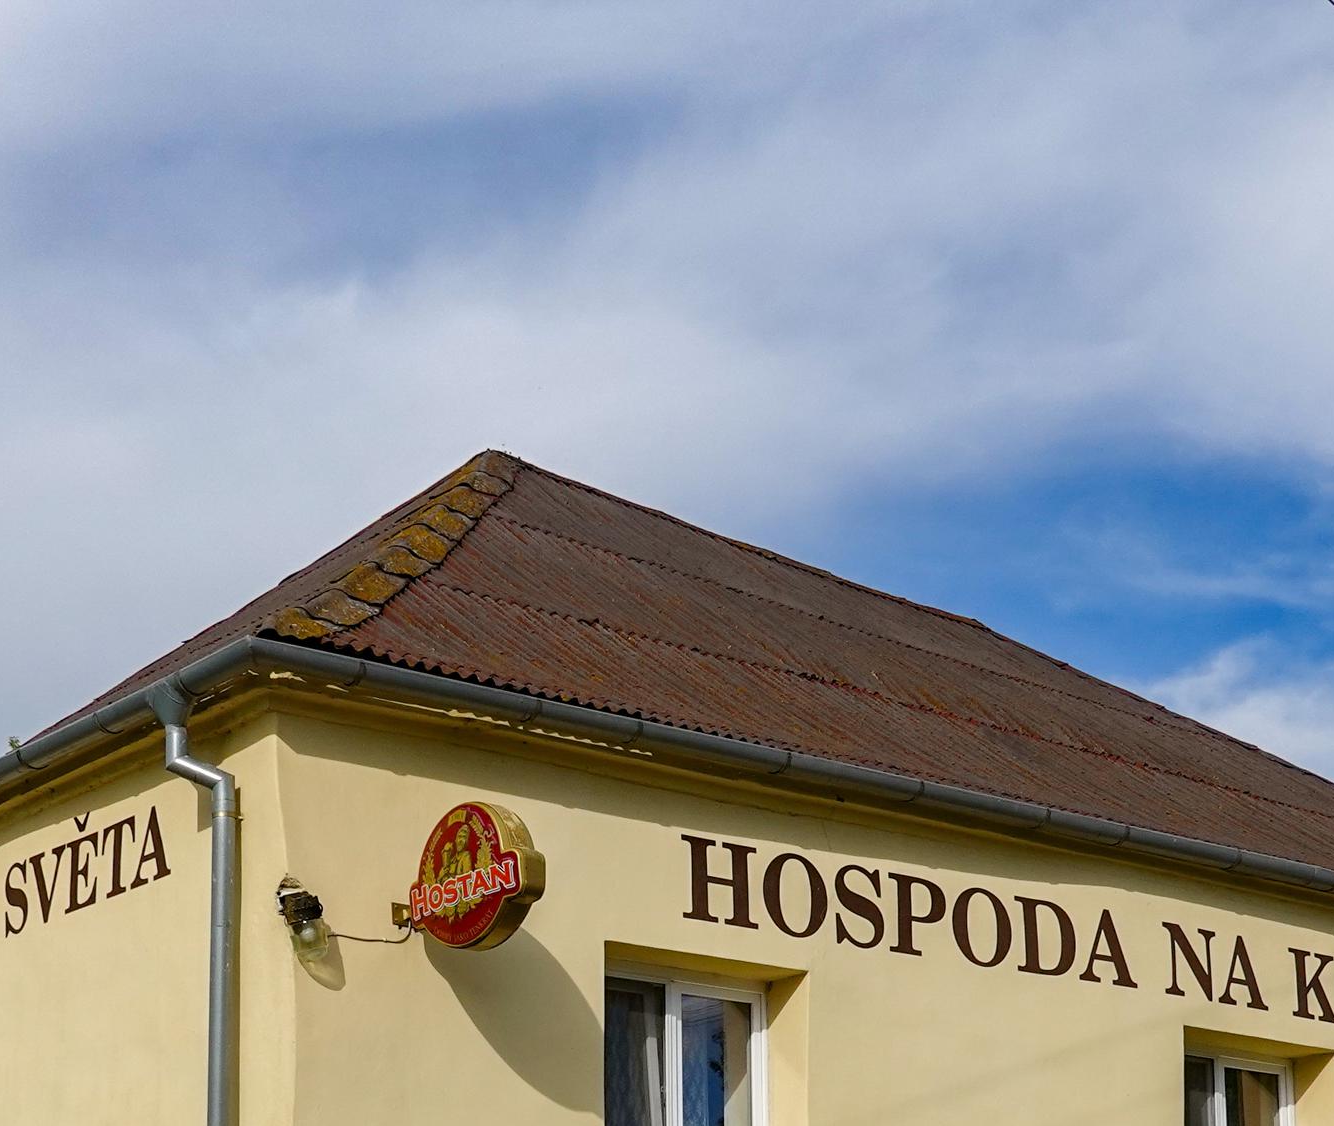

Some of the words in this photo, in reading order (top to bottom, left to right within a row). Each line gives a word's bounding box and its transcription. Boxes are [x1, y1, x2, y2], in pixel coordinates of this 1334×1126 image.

[4, 805, 172, 938] SVĚTA
[411, 859, 516, 922] HOSTAN
[680, 833, 1138, 989] HOSPODA
[1161, 921, 1269, 1012] NA
